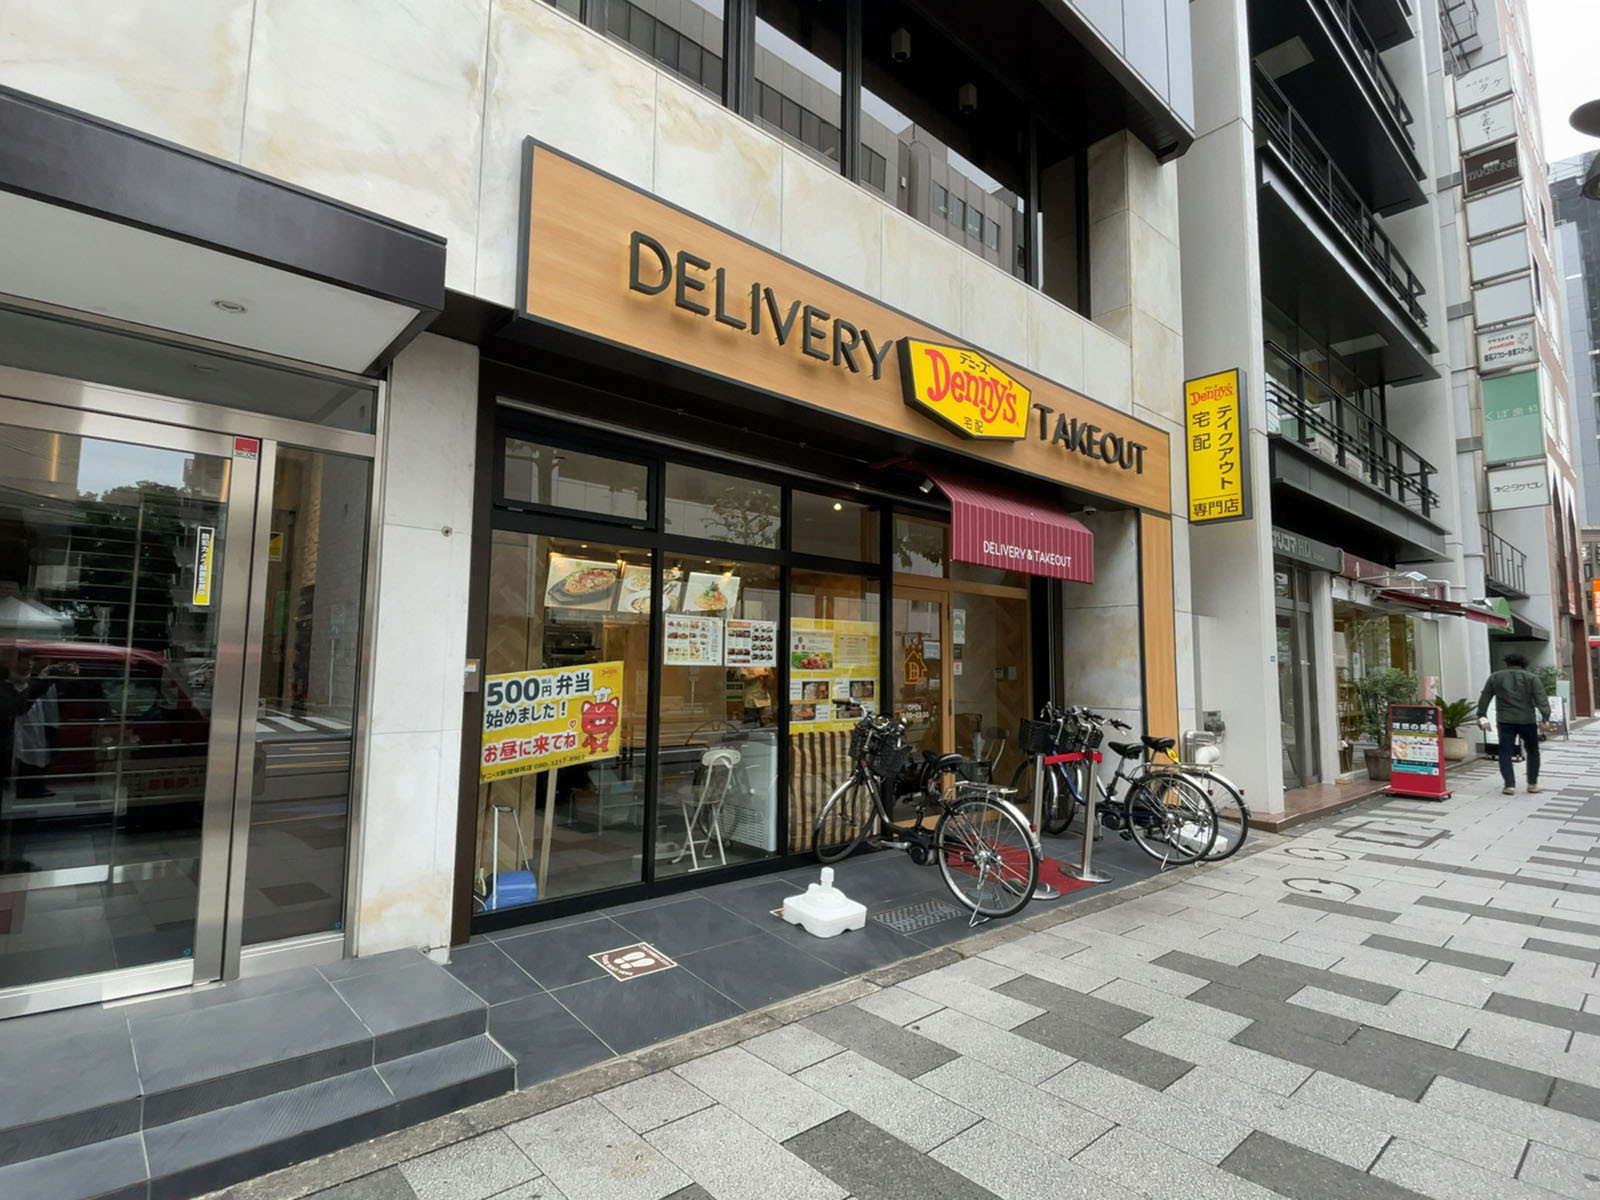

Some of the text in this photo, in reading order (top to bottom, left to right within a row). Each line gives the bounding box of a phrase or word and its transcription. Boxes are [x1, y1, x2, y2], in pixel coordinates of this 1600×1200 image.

[629, 231, 893, 380] DELIVERY
[960, 352, 991, 375] デニーズ
[924, 349, 1017, 424] Denny's
[1190, 382, 1234, 406] Denny's
[963, 416, 984, 434] 宅配
[1033, 403, 1148, 474] TAKEOUT
[1192, 411, 1212, 452] 宅配
[1216, 405, 1235, 490] テイクアウト
[1192, 498, 1239, 517] 専門店
[983, 540, 1072, 568] DELIVERY & TAKEOUT
[484, 731, 577, 764] お昼に来てね
